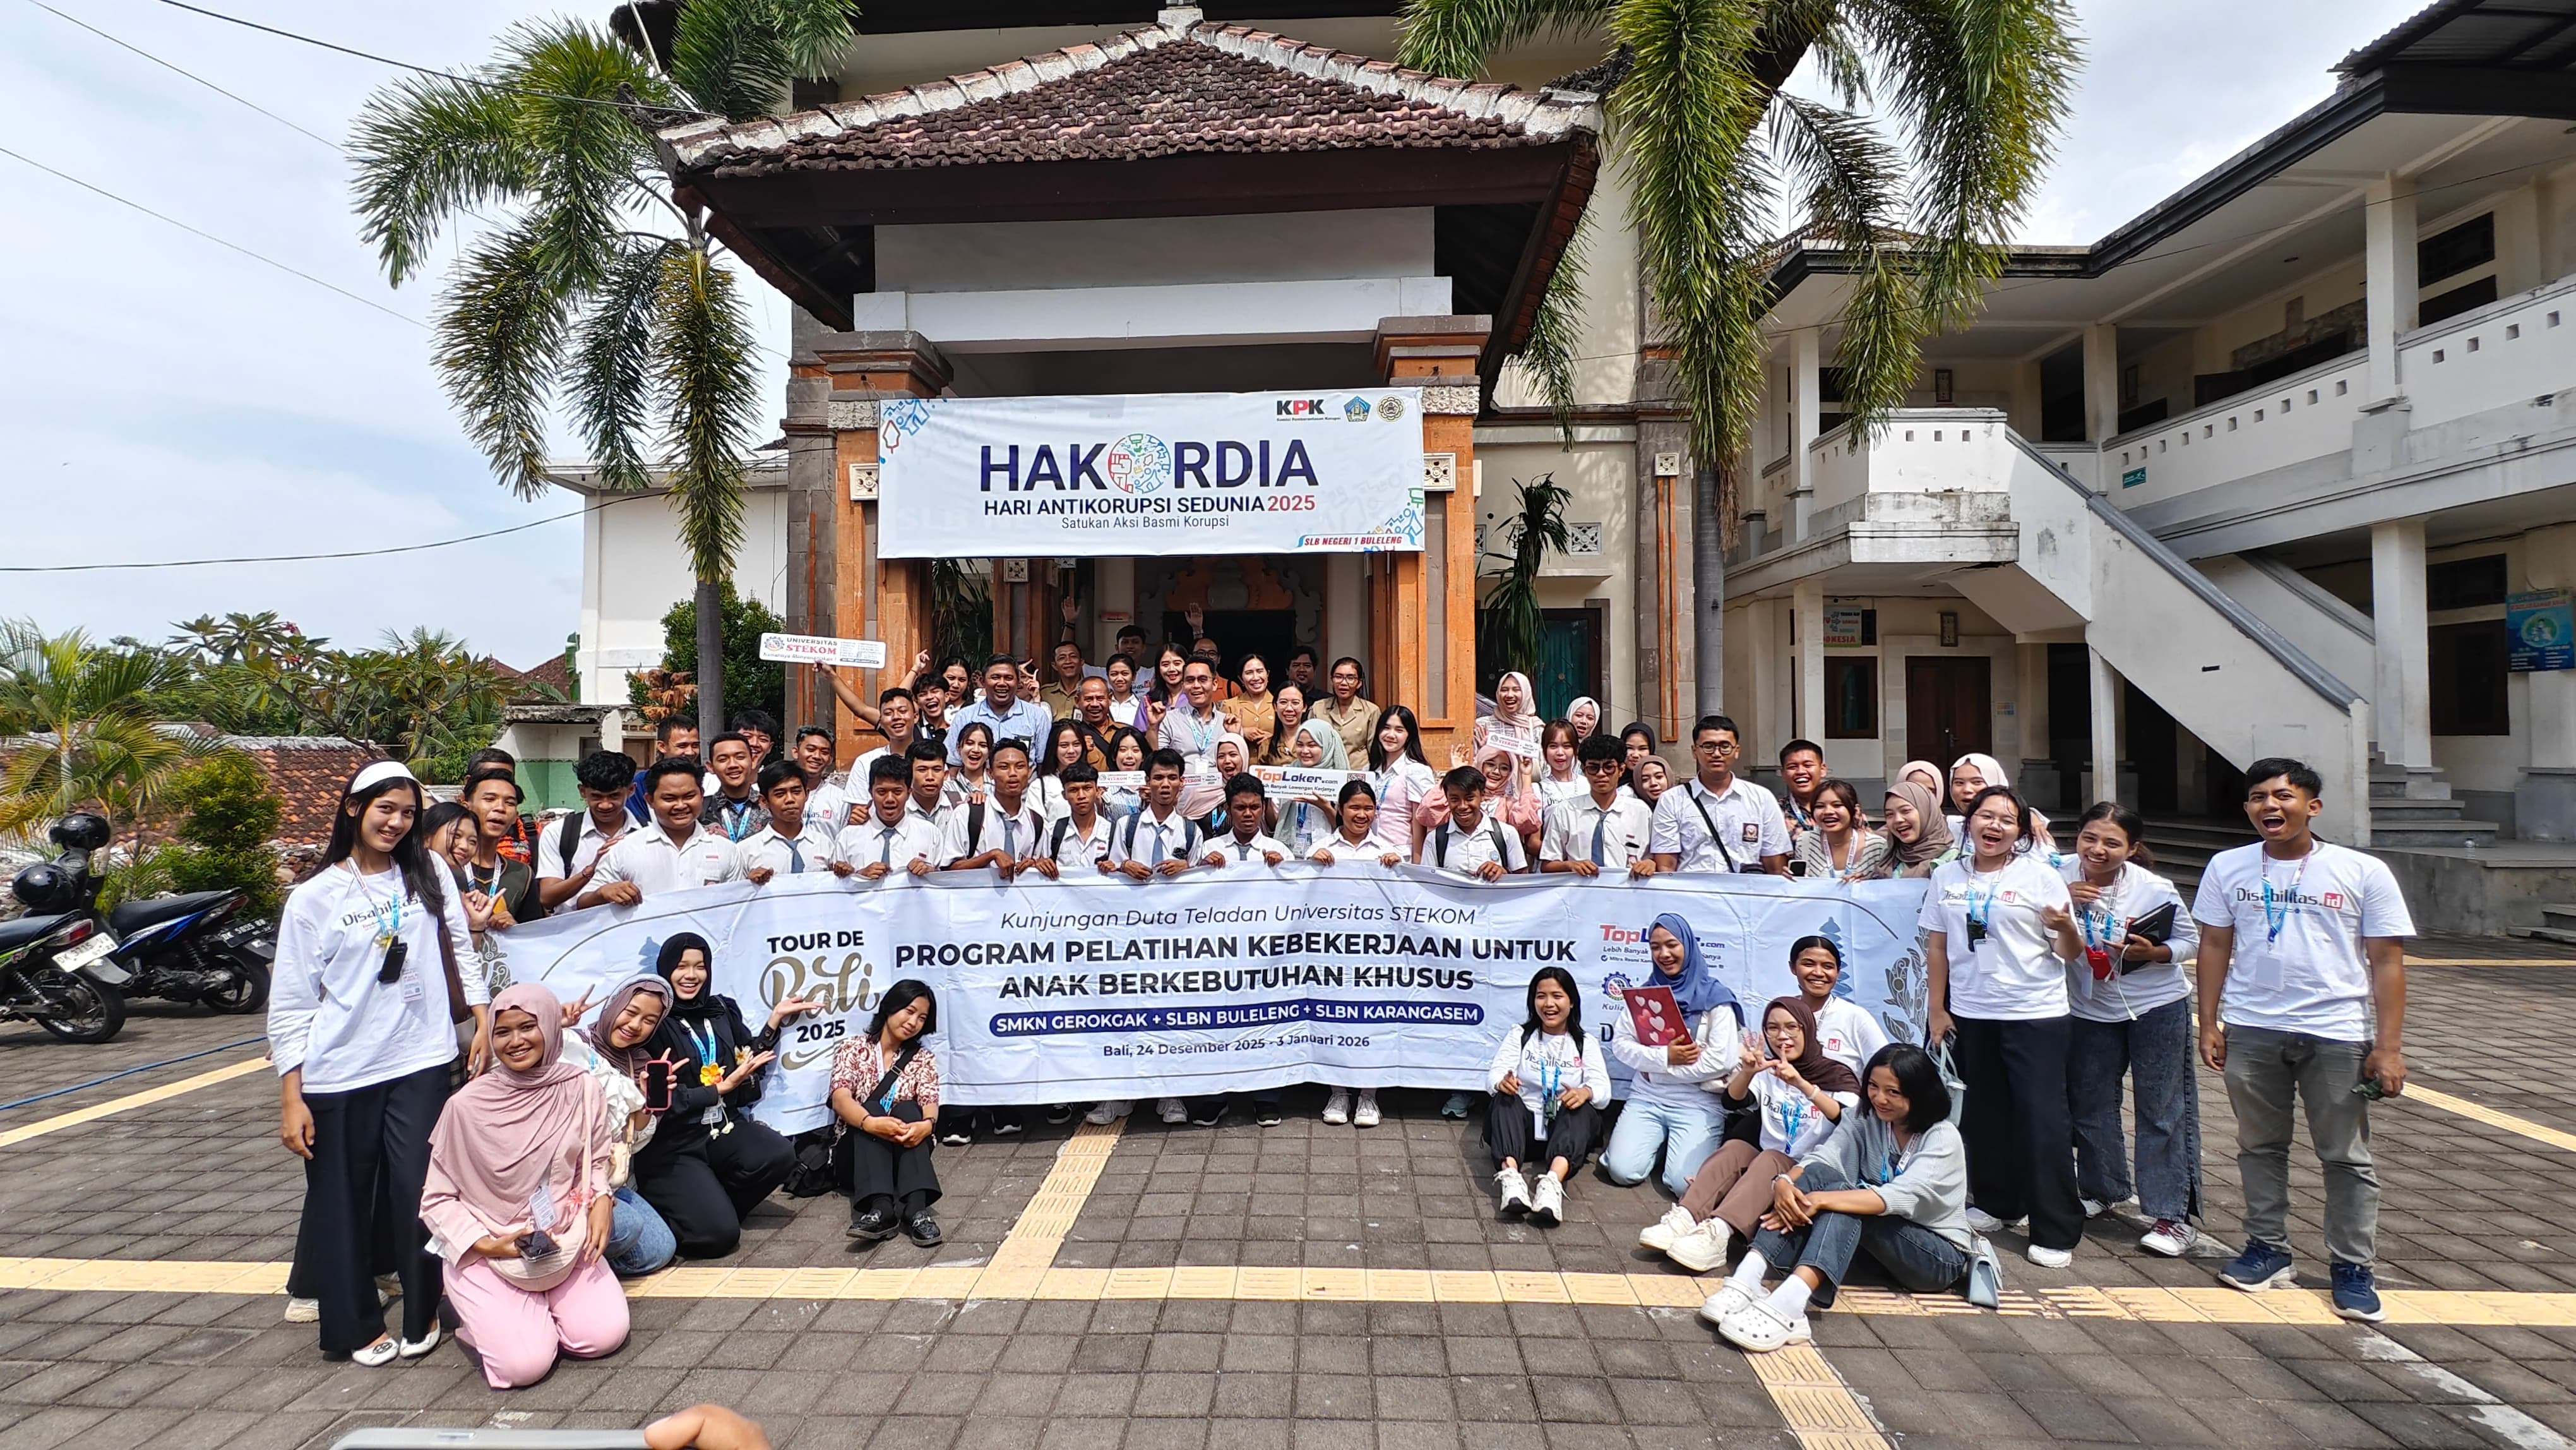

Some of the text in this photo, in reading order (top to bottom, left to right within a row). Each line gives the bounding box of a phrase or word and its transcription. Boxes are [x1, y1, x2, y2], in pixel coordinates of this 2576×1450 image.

[1276, 399, 1325, 416] KPK
[984, 494, 1316, 517] HARI ANTIKORUPSI SEDUNIA 2025
[1061, 513, 1230, 530] Satukan Aksi Basmi Korupsi
[1304, 536, 1403, 546] SLB NEGERI 1 BULELENG
[785, 644, 837, 656] STEKOM
[786, 637, 838, 647] UNIVERSITAS
[1255, 768, 1339, 785] TopLoker.com
[1001, 902, 1476, 933] Kunjungan Duta Teladan Universitas STEKOM
[766, 930, 864, 953] TOUR DE
[896, 932, 1577, 968] PROGRAM PELATIHAN KEBEKERJAAN UNTUK
[1623, 947, 1649, 956] Banyak
[760, 952, 880, 1028] Bali
[999, 966, 1474, 1000] ANAK BERKEBUTUHAN KHUSUS
[996, 1017, 1047, 1033] SMKN
[1051, 1012, 1148, 1030] GEROKGAK
[1166, 1011, 1213, 1026] SLBN
[1216, 1004, 1300, 1024] BULELENG
[1315, 1004, 1359, 1019] SLBN
[1363, 1005, 1479, 1021] KARANGASEM
[796, 1019, 845, 1043] 2025
[1103, 1045, 1134, 1058] Bali,
[1138, 1045, 1155, 1056] 24
[1157, 1041, 1230, 1056] Desember
[1234, 1039, 1265, 1052] 2025
[1277, 1036, 1285, 1047] 3
[1286, 1033, 1333, 1046] Januari
[1337, 1036, 1370, 1048] 2026
